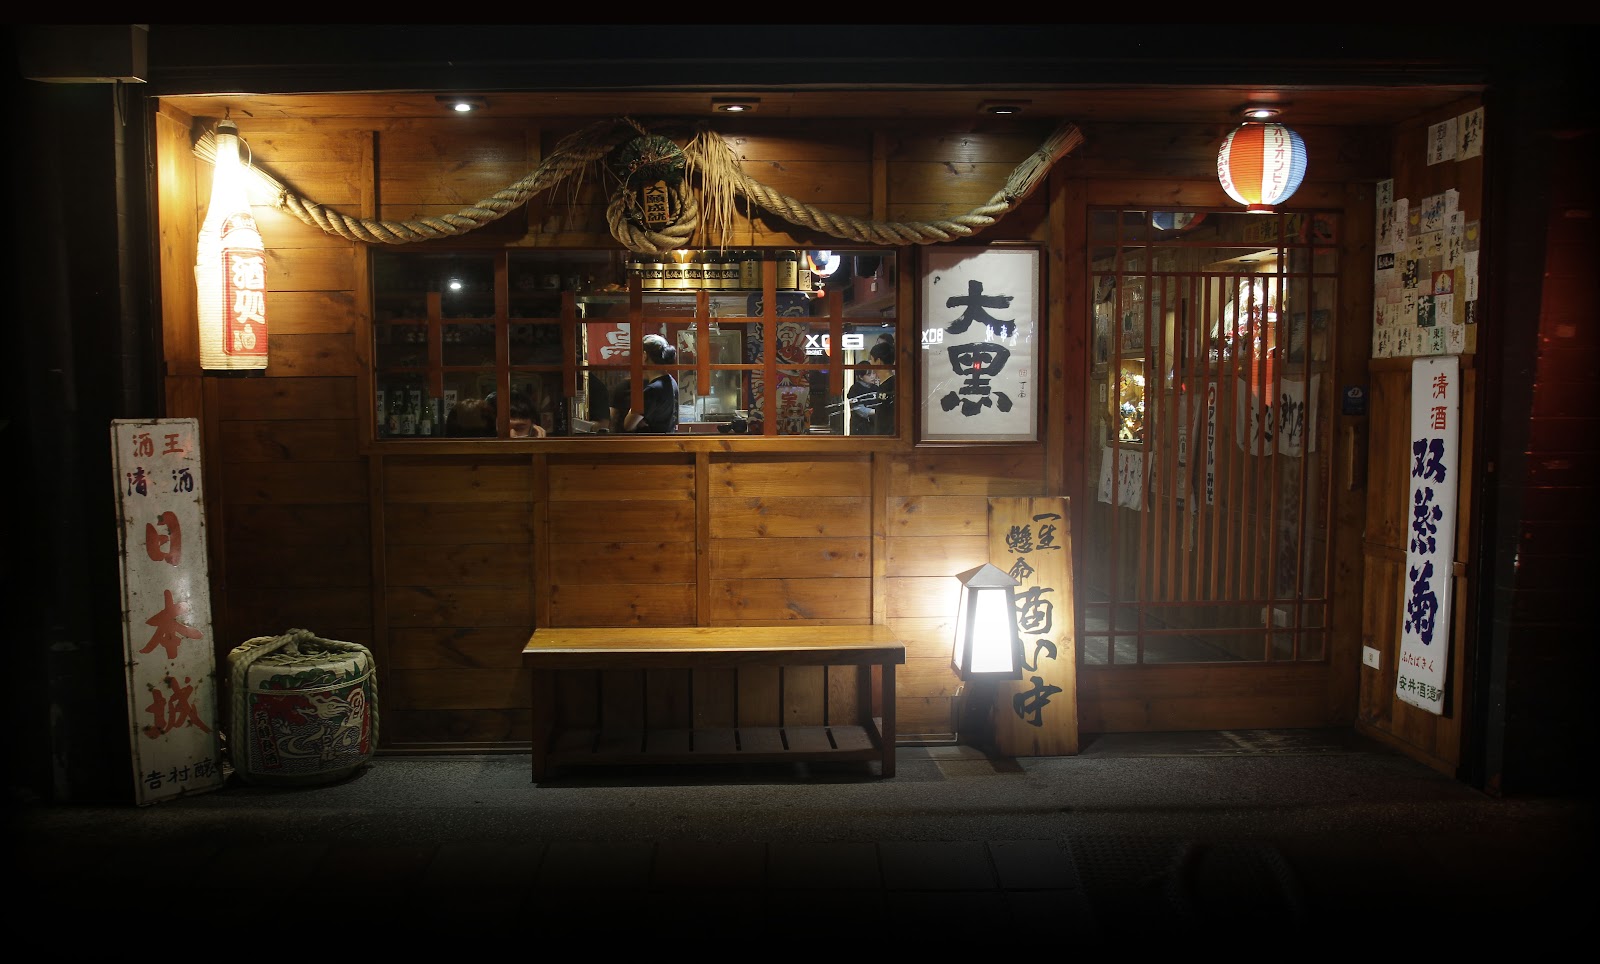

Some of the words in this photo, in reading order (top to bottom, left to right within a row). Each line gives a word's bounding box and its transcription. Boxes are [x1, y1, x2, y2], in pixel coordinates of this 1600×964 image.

[646, 185, 667, 222] 大願成就
[232, 255, 264, 324] 酒処
[1430, 372, 1449, 431] 清酒
[127, 467, 194, 497] 清酒
[139, 510, 211, 739] 日本城
[1401, 651, 1434, 673] ふたばきく
